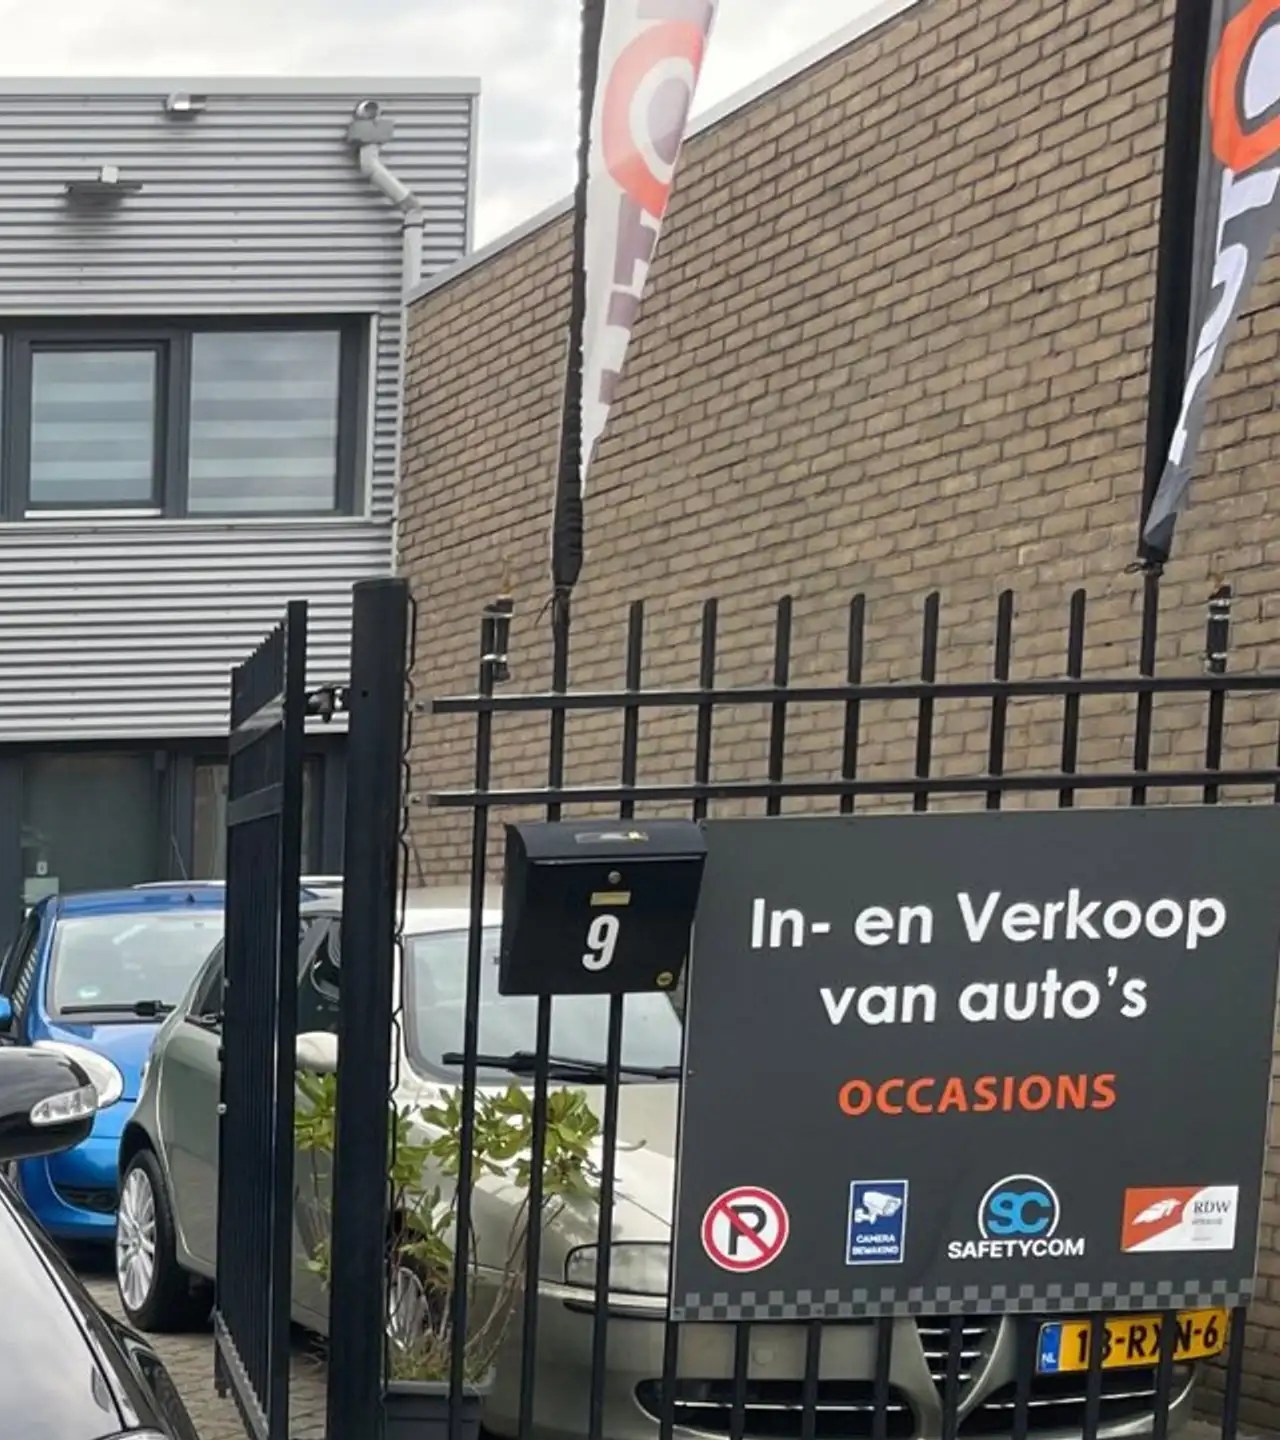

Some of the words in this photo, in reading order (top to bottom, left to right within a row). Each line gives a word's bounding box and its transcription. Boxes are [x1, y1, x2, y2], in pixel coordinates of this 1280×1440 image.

[582, 914, 620, 971] 9
[751, 898, 831, 948] In-
[854, 905, 934, 946] en
[957, 888, 1227, 949] Verkoop
[820, 984, 937, 1025] van
[958, 966, 1148, 1022] auto's
[839, 1074, 1117, 1116] OCCASIONS
[1193, 1200, 1231, 1214] RDW
[947, 1238, 1087, 1260] SAFETYCOM
